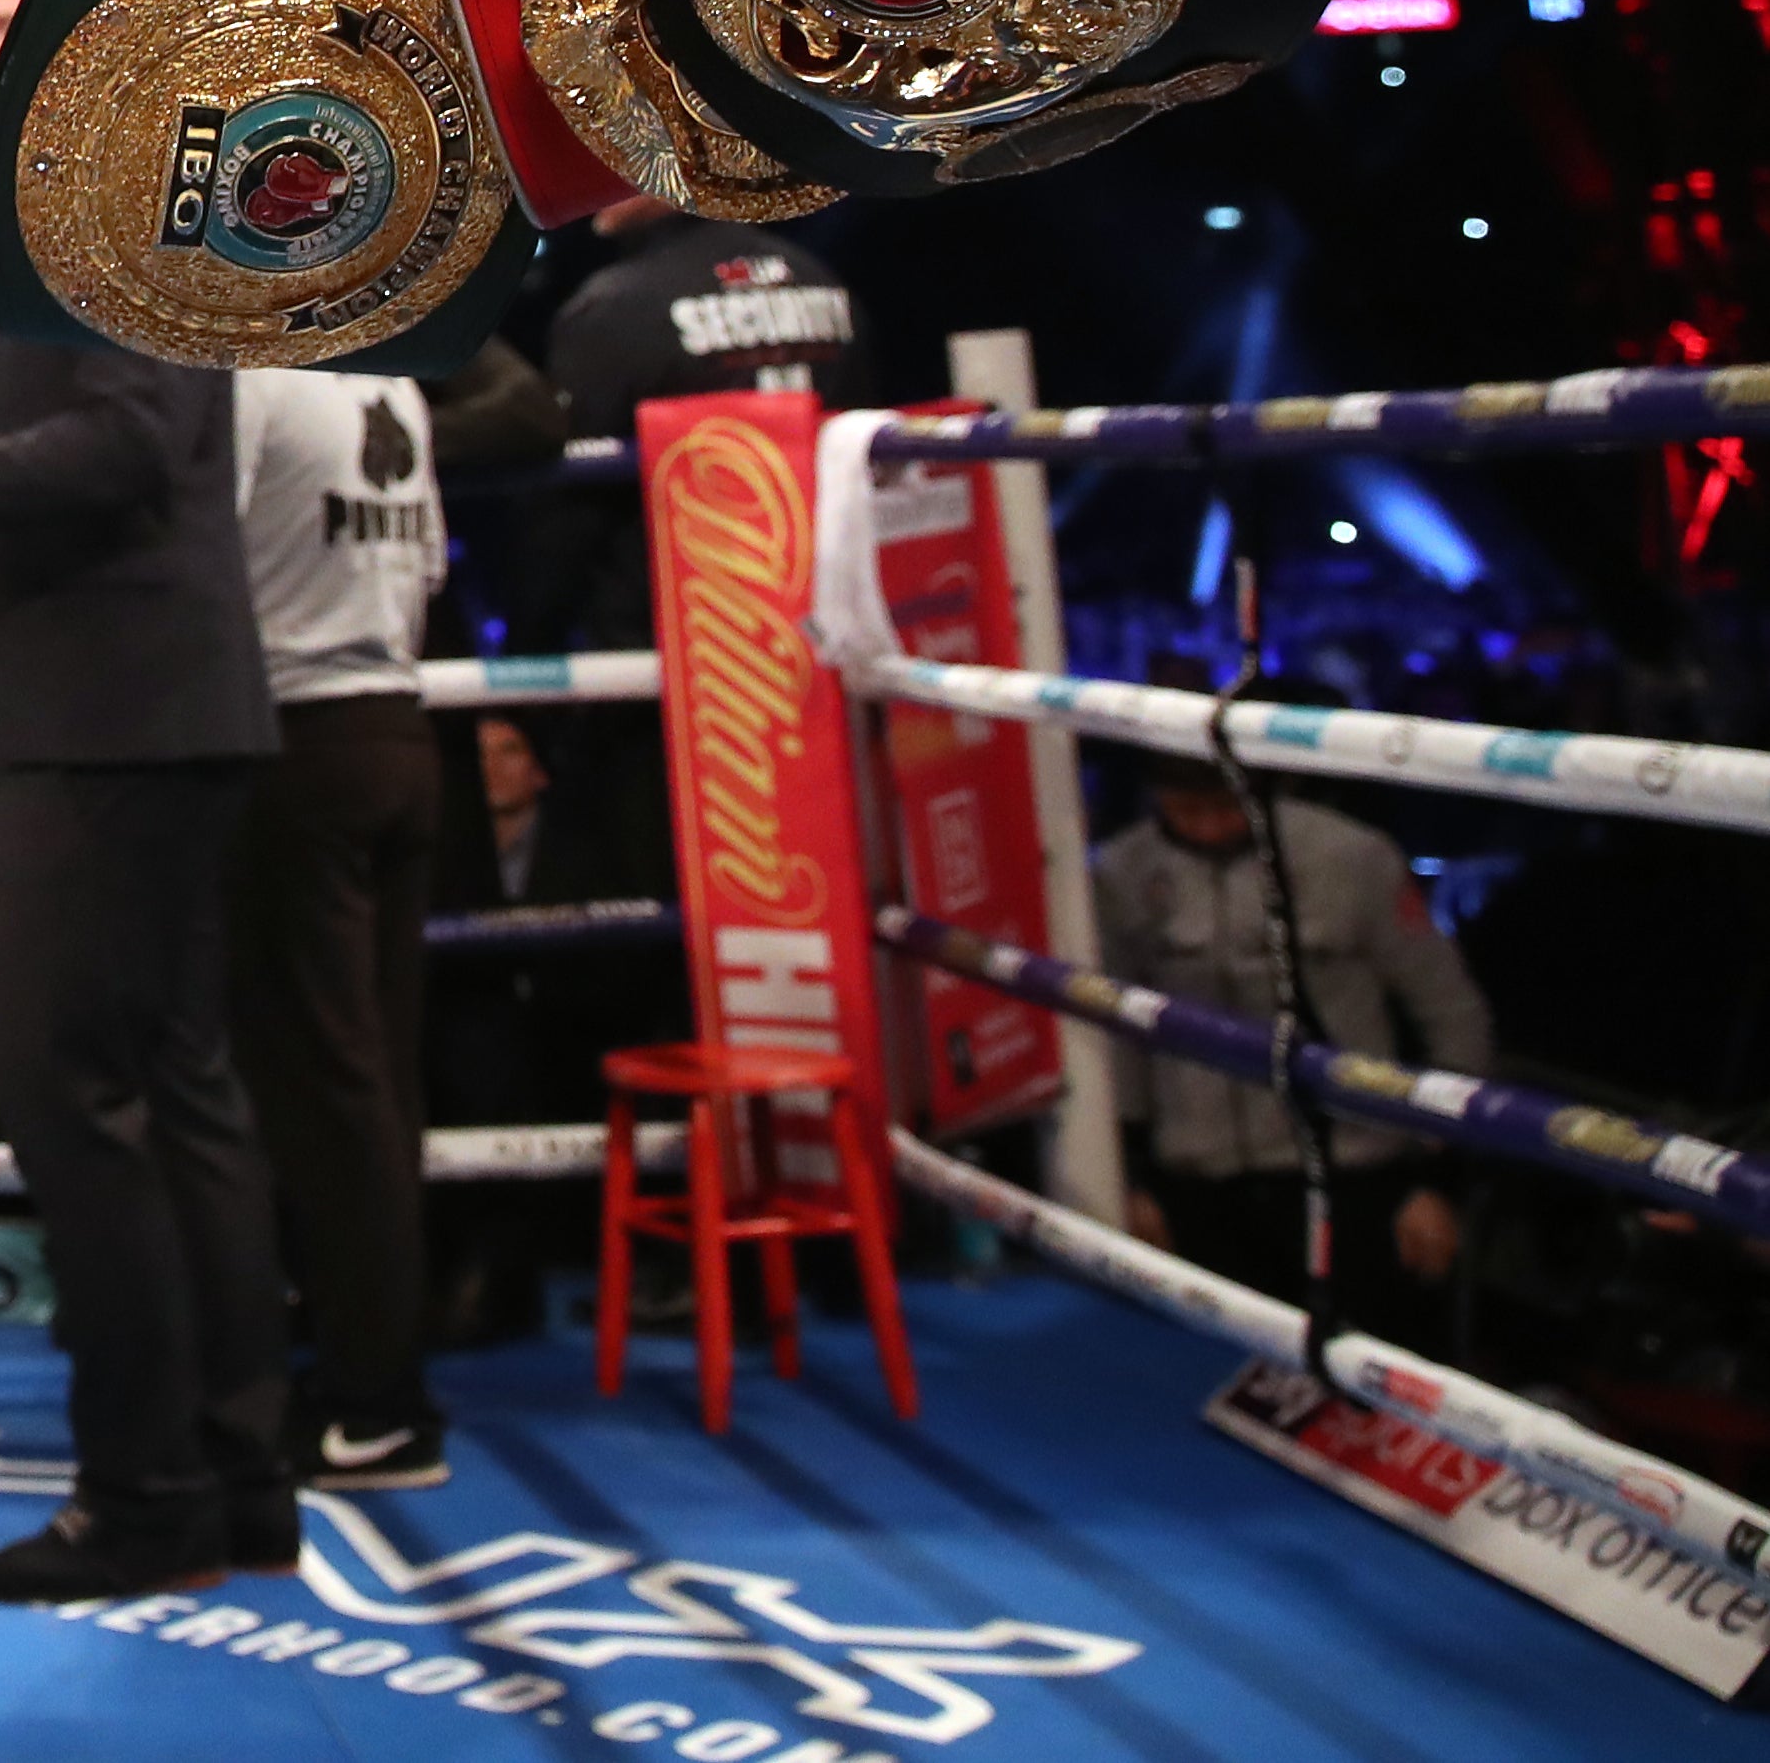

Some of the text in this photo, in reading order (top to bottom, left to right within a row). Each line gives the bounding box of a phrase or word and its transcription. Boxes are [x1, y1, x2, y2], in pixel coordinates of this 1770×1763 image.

[370, 15, 467, 139] WORLD
[173, 124, 218, 236] IBO
[215, 142, 252, 229] BOXING
